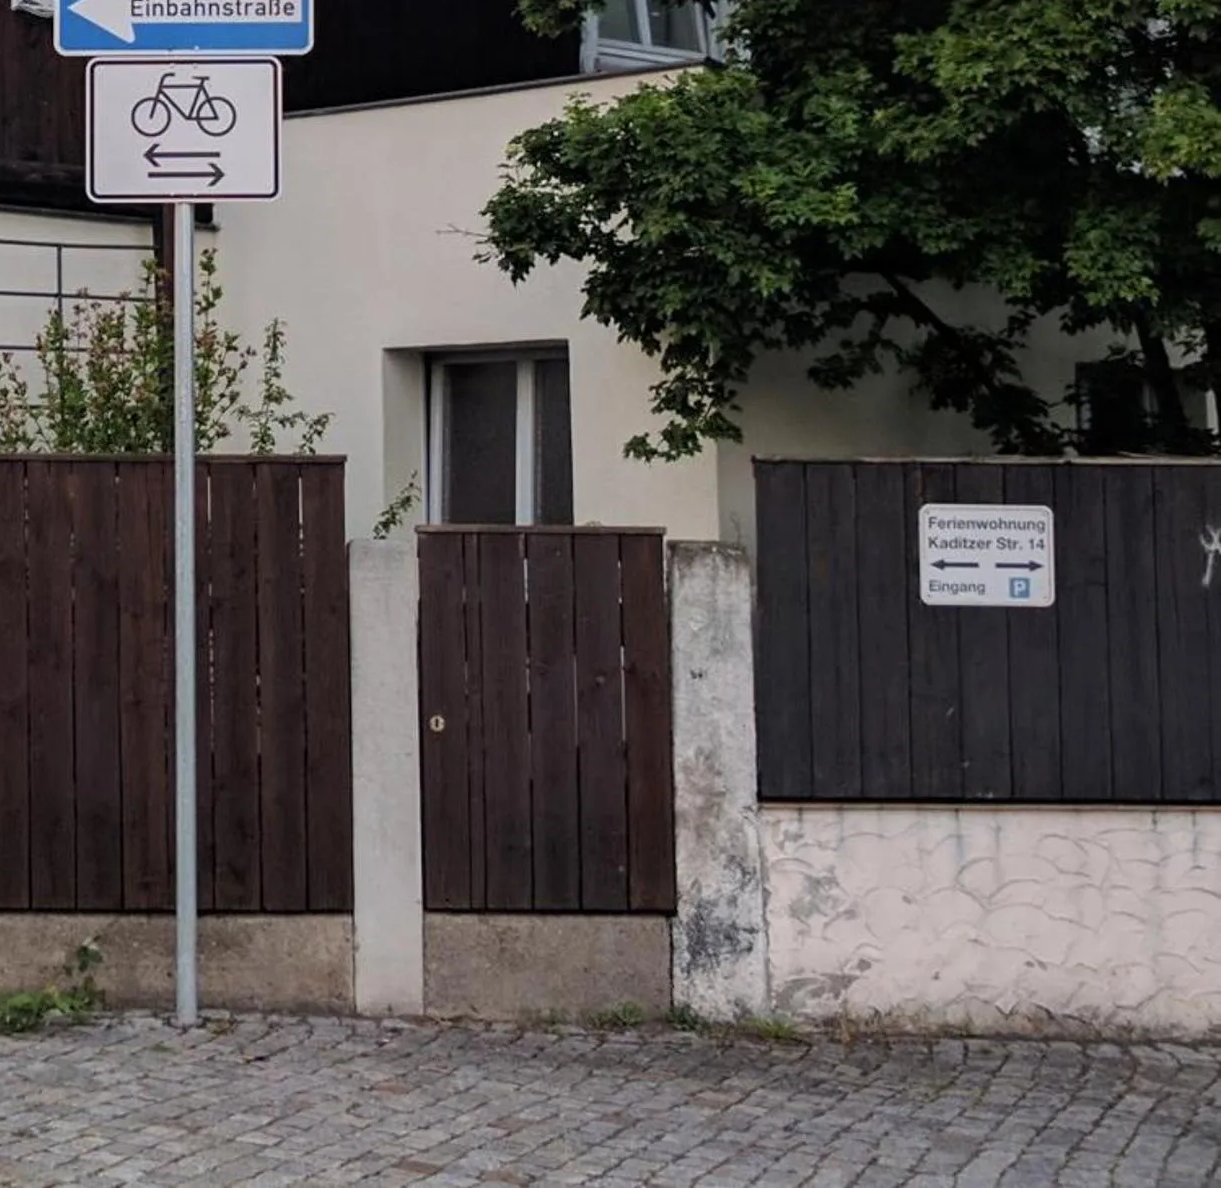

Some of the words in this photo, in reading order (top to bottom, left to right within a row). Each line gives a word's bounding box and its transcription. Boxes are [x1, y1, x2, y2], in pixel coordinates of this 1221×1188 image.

[928, 517, 1046, 533] Ferienwohnung
[928, 537, 991, 549] Kaditzer
[996, 537, 1023, 550] Str.
[1029, 539, 1045, 550] 14
[928, 580, 986, 595] Eingang
